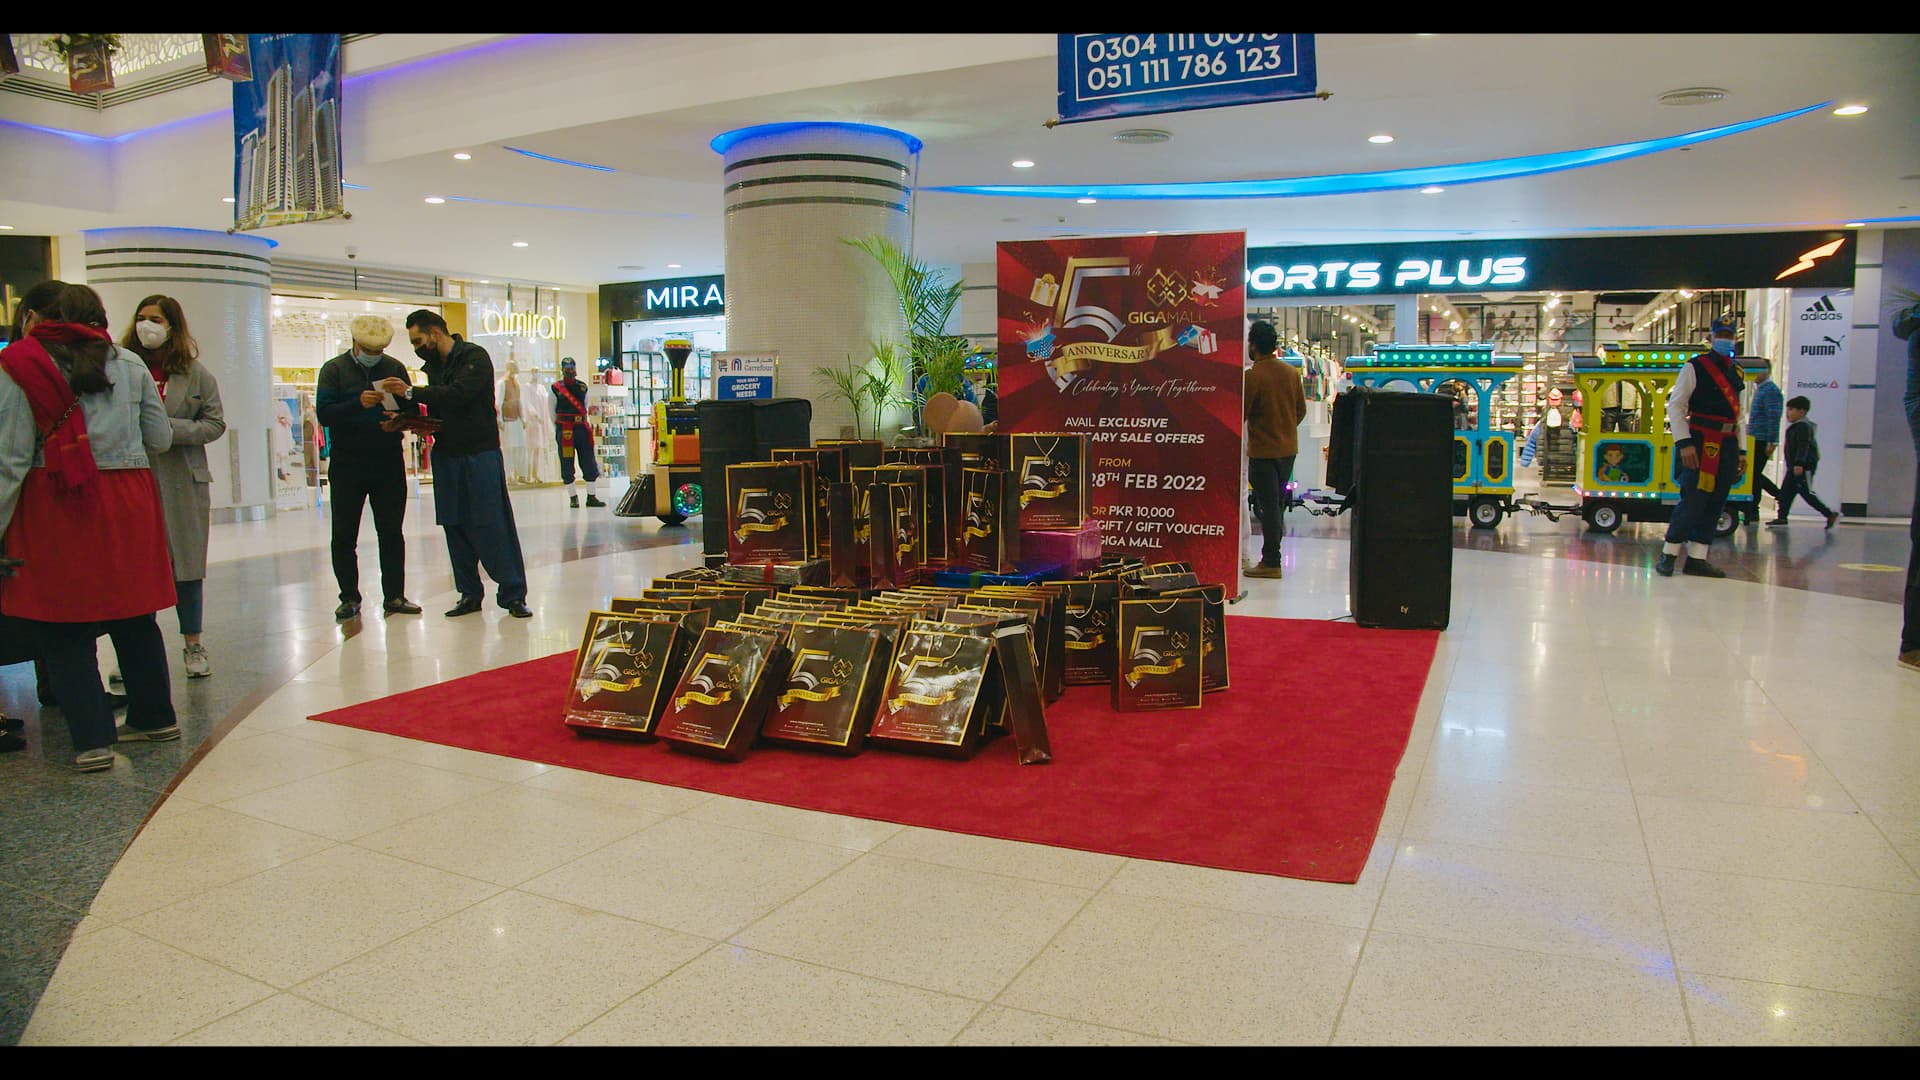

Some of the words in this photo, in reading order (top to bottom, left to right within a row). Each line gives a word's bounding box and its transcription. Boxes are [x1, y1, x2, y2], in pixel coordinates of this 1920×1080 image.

[1087, 34, 1157, 63] 0304
[1168, 33, 1195, 53] 111
[1087, 64, 1132, 91] 051
[1140, 59, 1170, 84] 111
[1177, 51, 1228, 80] 786
[1236, 45, 1281, 73] 123
[1245, 261, 1382, 291] ORTS
[1394, 256, 1528, 286] PLUS
[646, 283, 724, 310] MIRA
[483, 304, 567, 340] almirah
[1801, 311, 1842, 321] adidas
[1066, 343, 1153, 361] ANNIVERSARY
[1801, 345, 1835, 356] PUMA
[1072, 378, 1120, 397] Celebrating
[1797, 380, 1828, 389] Reebok
[1065, 417, 1095, 428] AVAIL
[1098, 418, 1169, 428] EXCLUSIVE
[1120, 433, 1152, 443] SALE
[1155, 434, 1205, 445] OFFERS
[1098, 458, 1132, 468] FROM
[1125, 474, 1158, 490] FEB
[1162, 475, 1206, 491] 2022
[1109, 506, 1132, 516] PKR
[1136, 506, 1175, 519] 10,000
[1135, 522, 1163, 534] GIFT
[1165, 523, 1225, 536] VOUCHER
[1129, 537, 1163, 549] MALL
